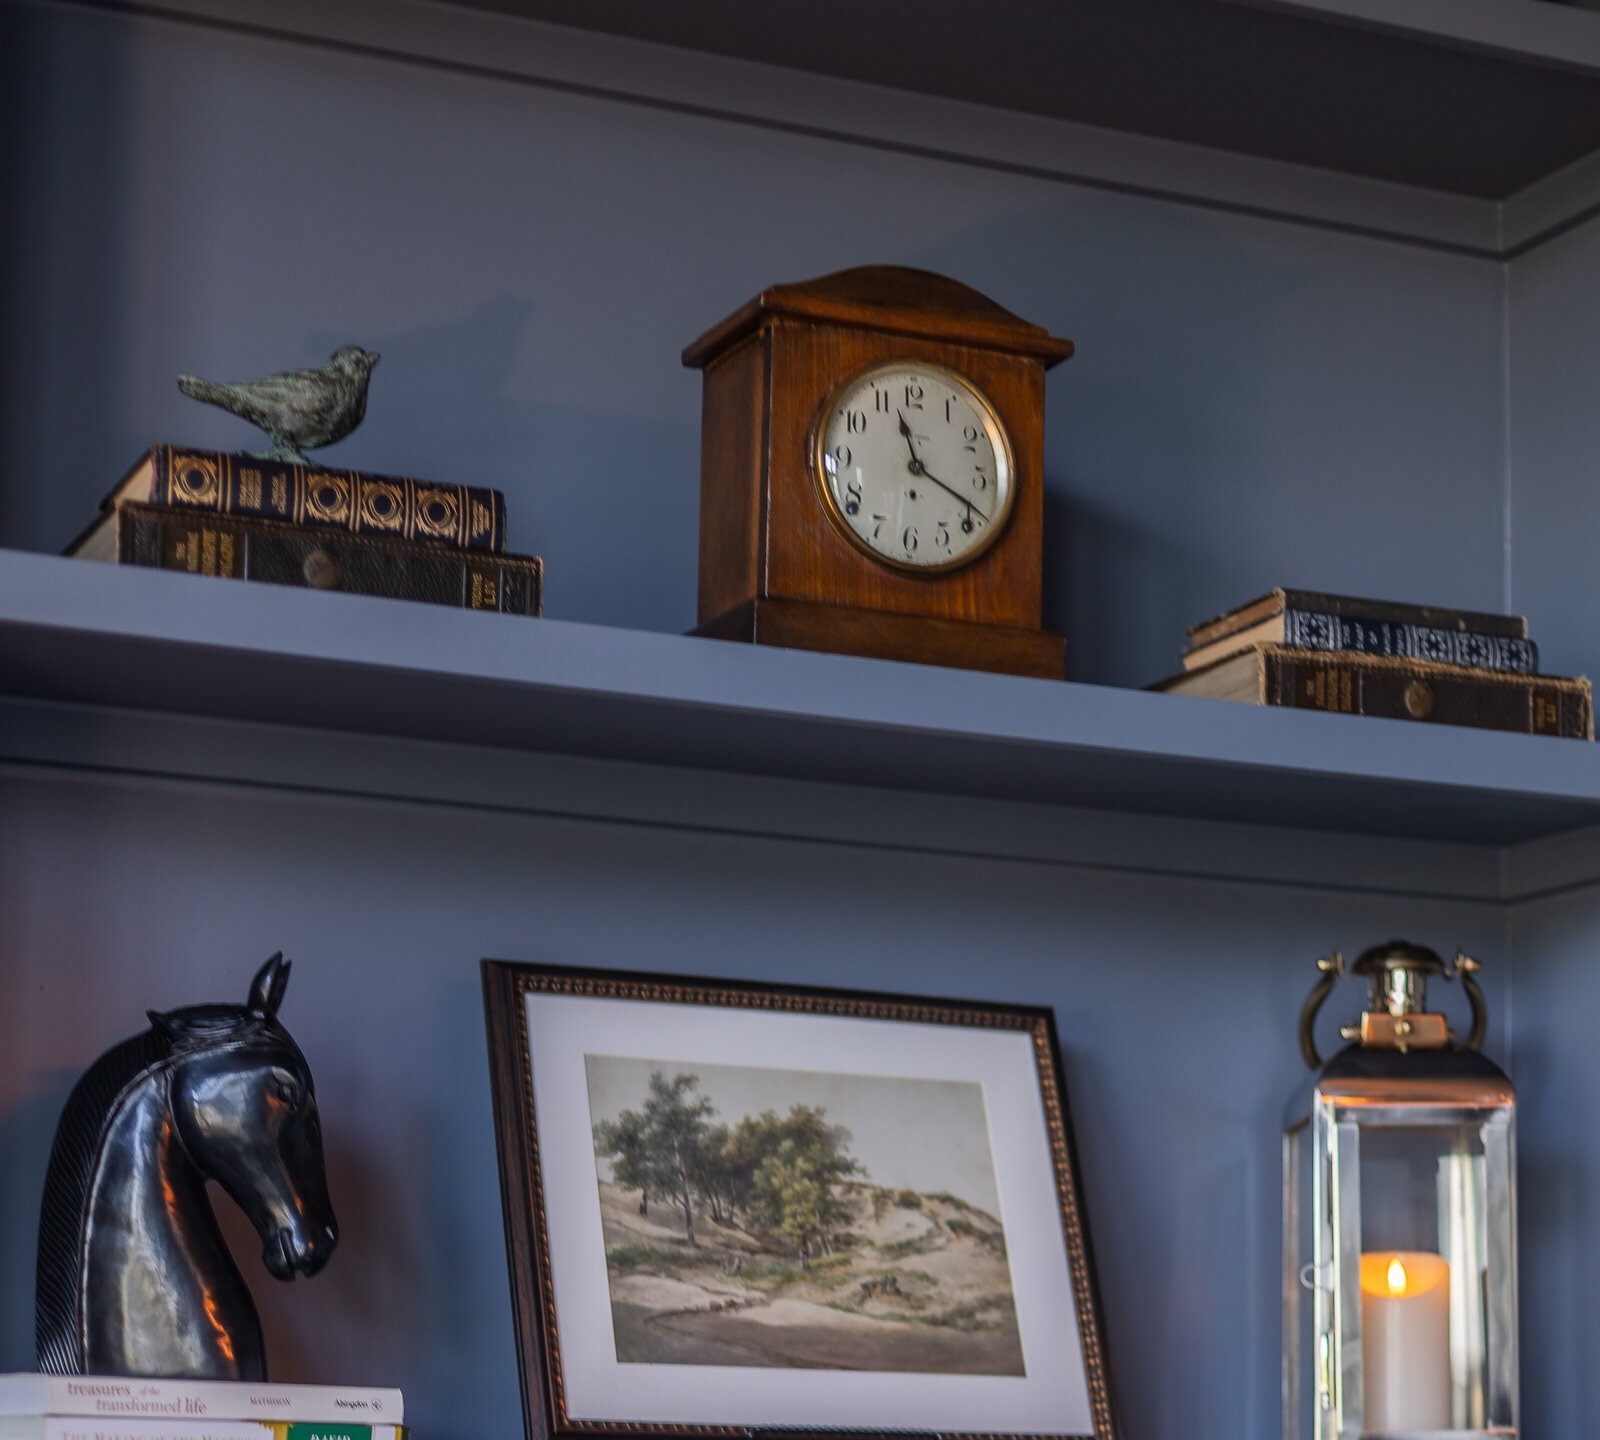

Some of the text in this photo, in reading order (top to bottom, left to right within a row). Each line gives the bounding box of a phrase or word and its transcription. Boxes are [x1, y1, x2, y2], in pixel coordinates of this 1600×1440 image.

[875, 388, 889, 413] 11
[904, 384, 924, 411] 12
[846, 409, 867, 434] 10
[945, 398, 951, 423] 1
[963, 425, 978, 454] 2
[836, 444, 852, 469] 9
[972, 465, 987, 491] 3
[872, 513, 887, 539] 7
[935, 520, 950, 548] 5
[902, 526, 918, 552] 6
[67, 1381, 131, 1396] treasures
[96, 1396, 208, 1415] transformed life
